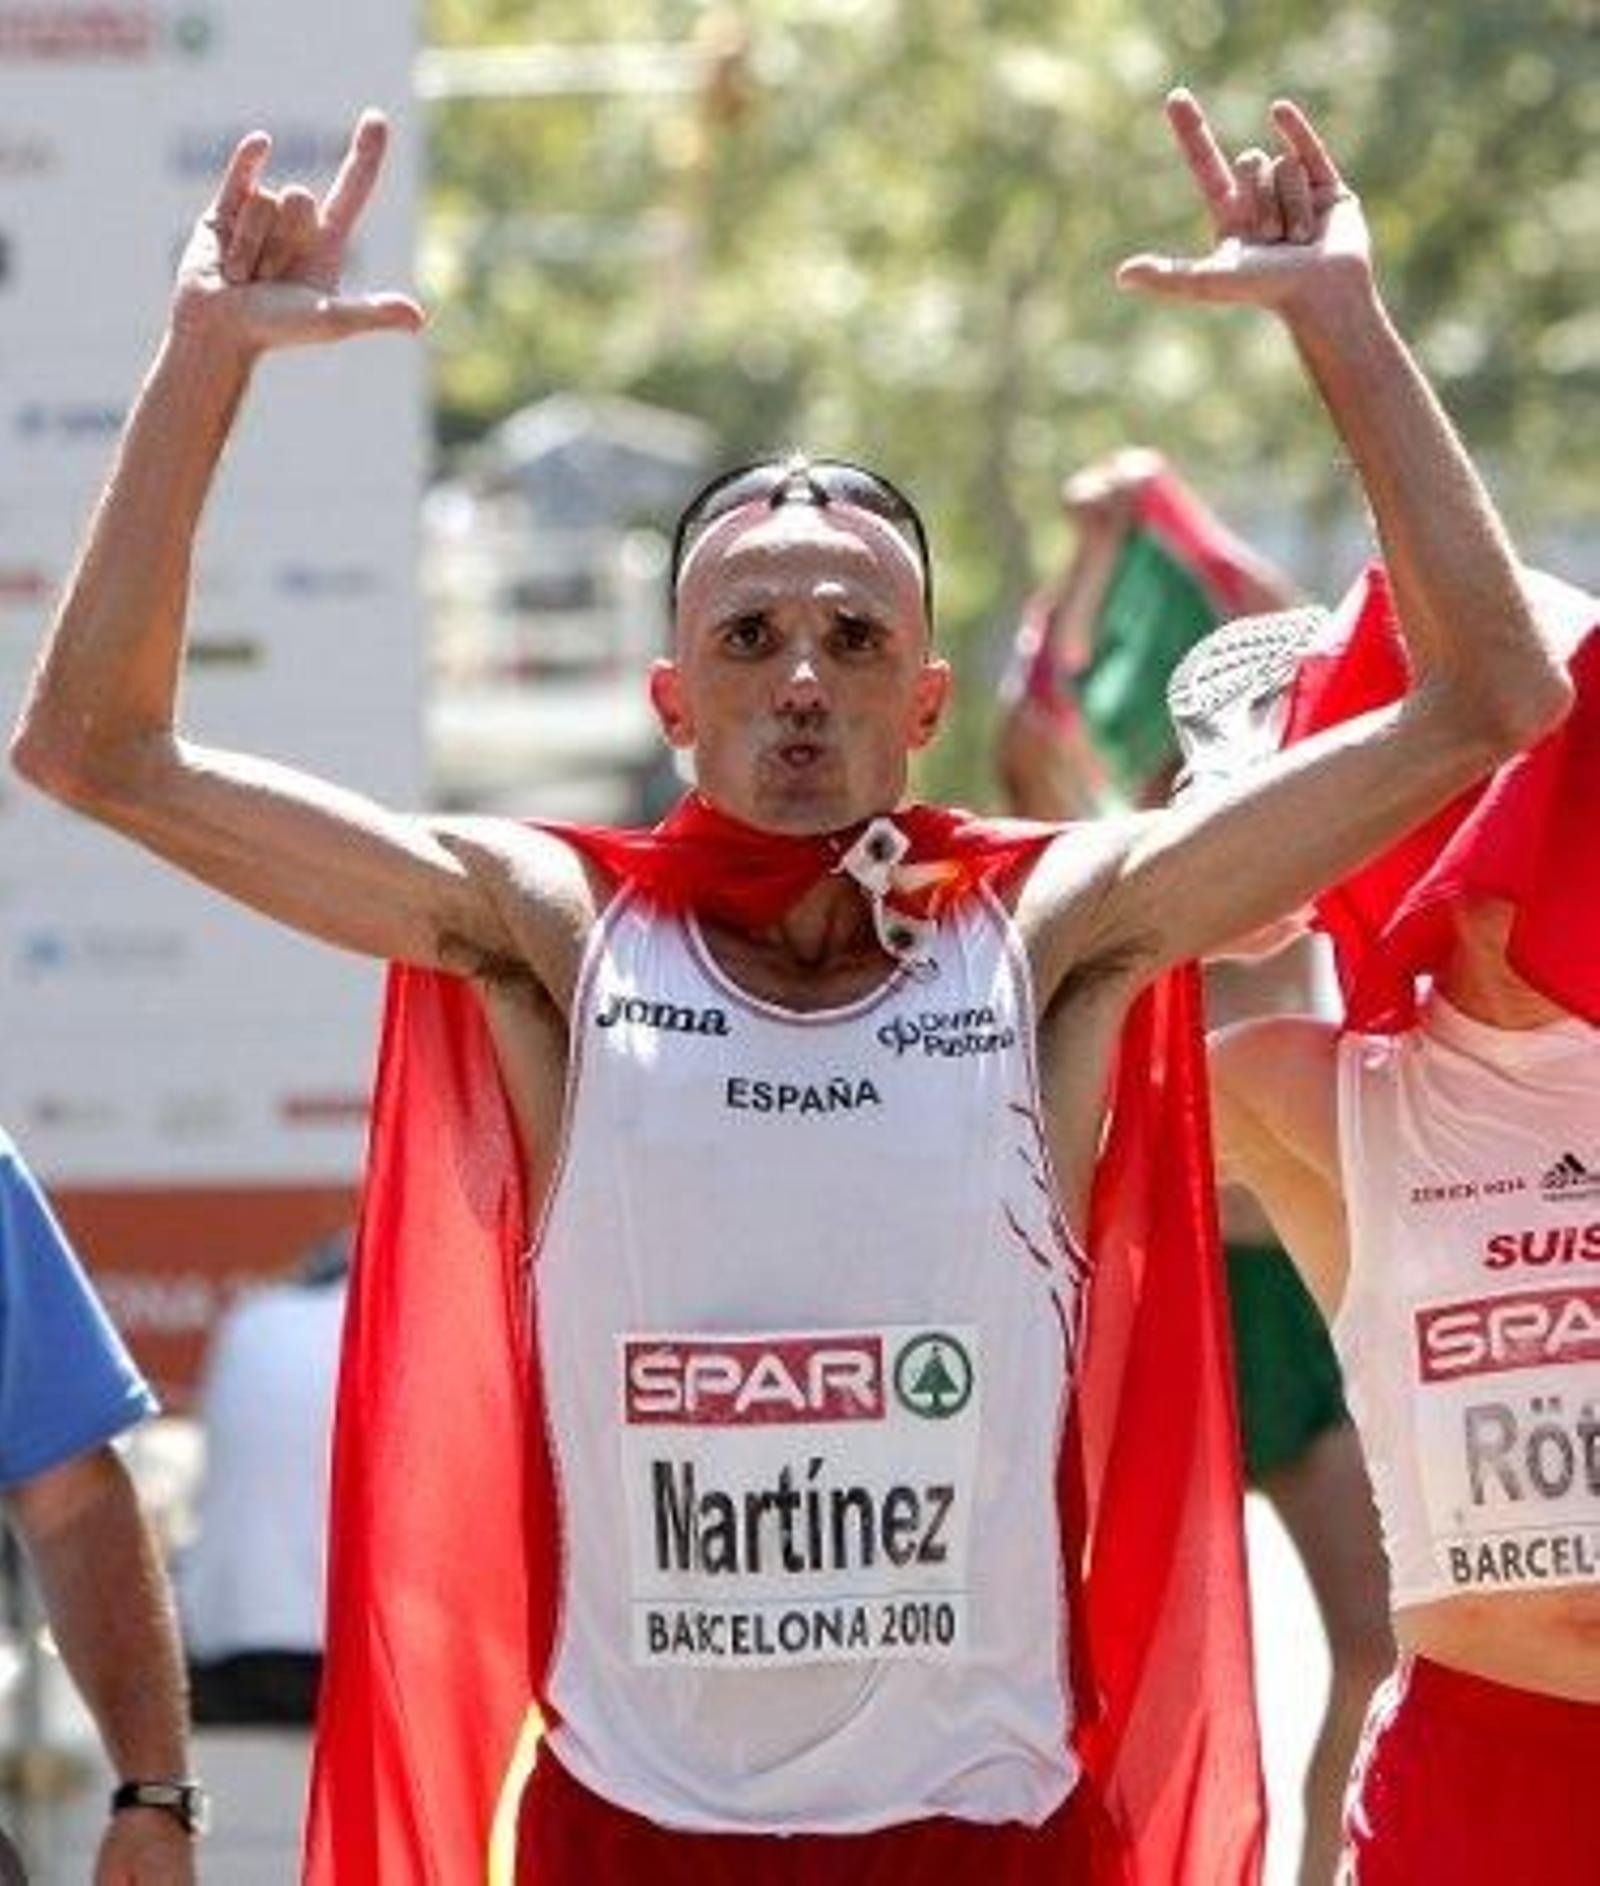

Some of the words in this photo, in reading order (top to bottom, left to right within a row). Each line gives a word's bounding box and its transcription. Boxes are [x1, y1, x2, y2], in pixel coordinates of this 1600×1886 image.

[726, 1075, 883, 1115] ESPAÑA
[631, 1350, 876, 1413] SPAR
[651, 1457, 955, 1574] Martínez
[1449, 1534, 1600, 1583] BARCEL
[647, 1607, 870, 1656] BARCELONA
[882, 1602, 956, 1647] 2010
